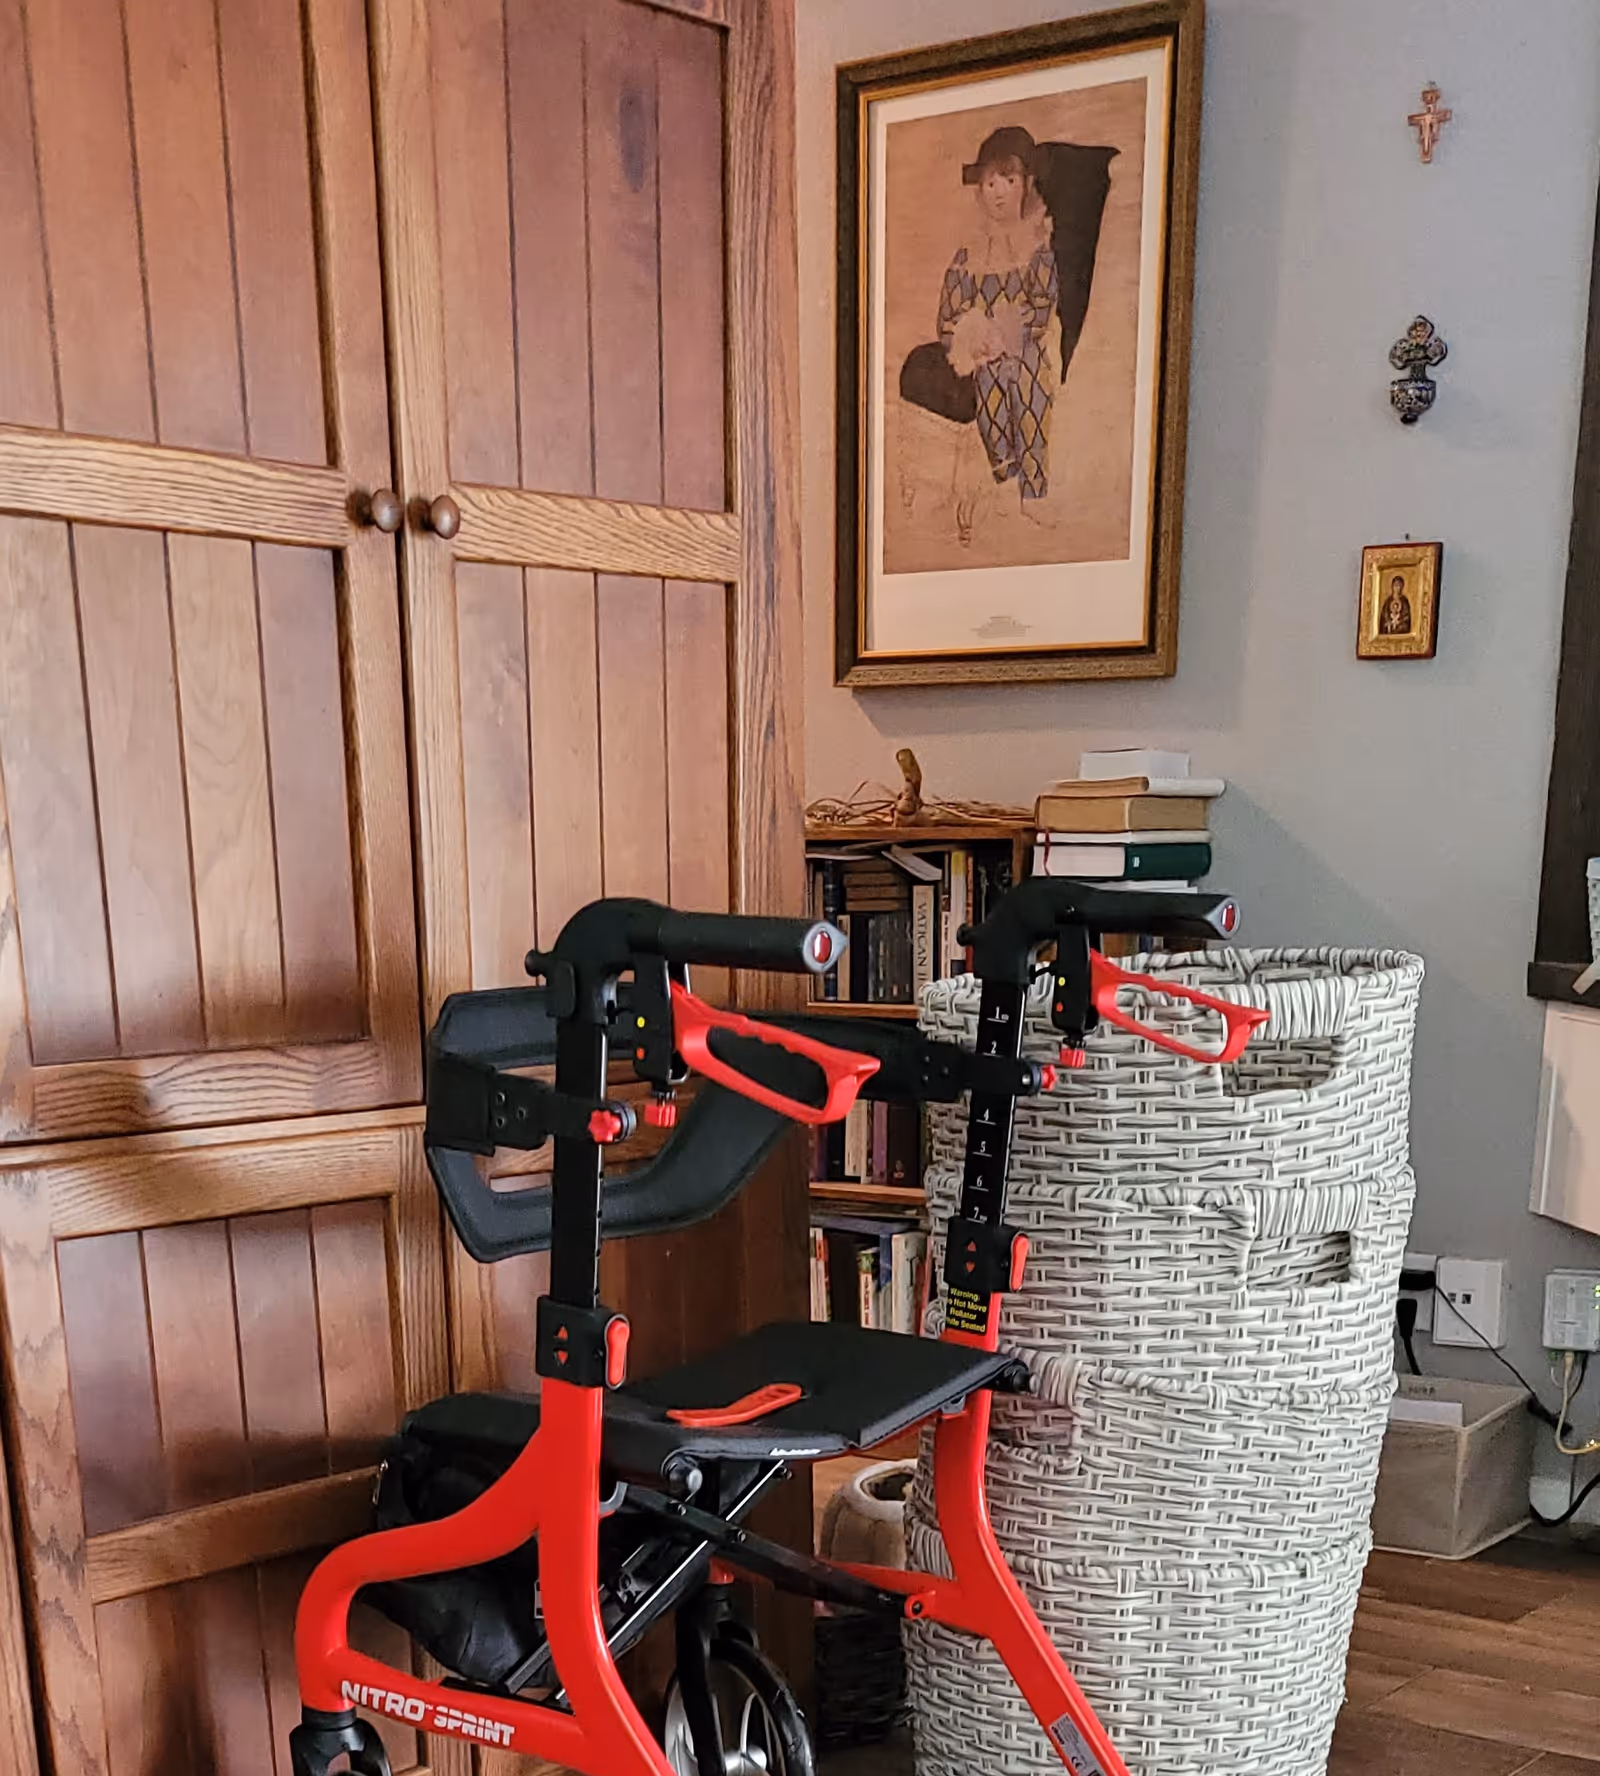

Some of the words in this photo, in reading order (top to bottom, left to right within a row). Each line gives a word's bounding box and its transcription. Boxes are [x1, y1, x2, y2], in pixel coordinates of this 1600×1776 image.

[917, 902, 928, 967] VATICAN
[917, 973, 928, 981] II
[991, 1042, 997, 1054] 2
[983, 1108, 990, 1121] 4
[980, 1141, 987, 1153] 5
[976, 1175, 983, 1187] 6
[954, 1299, 966, 1308] Not
[967, 1301, 987, 1312] Move
[950, 1307, 977, 1320] Rollator
[961, 1320, 986, 1332] Seated
[434, 1706, 515, 1746] SPRINT
